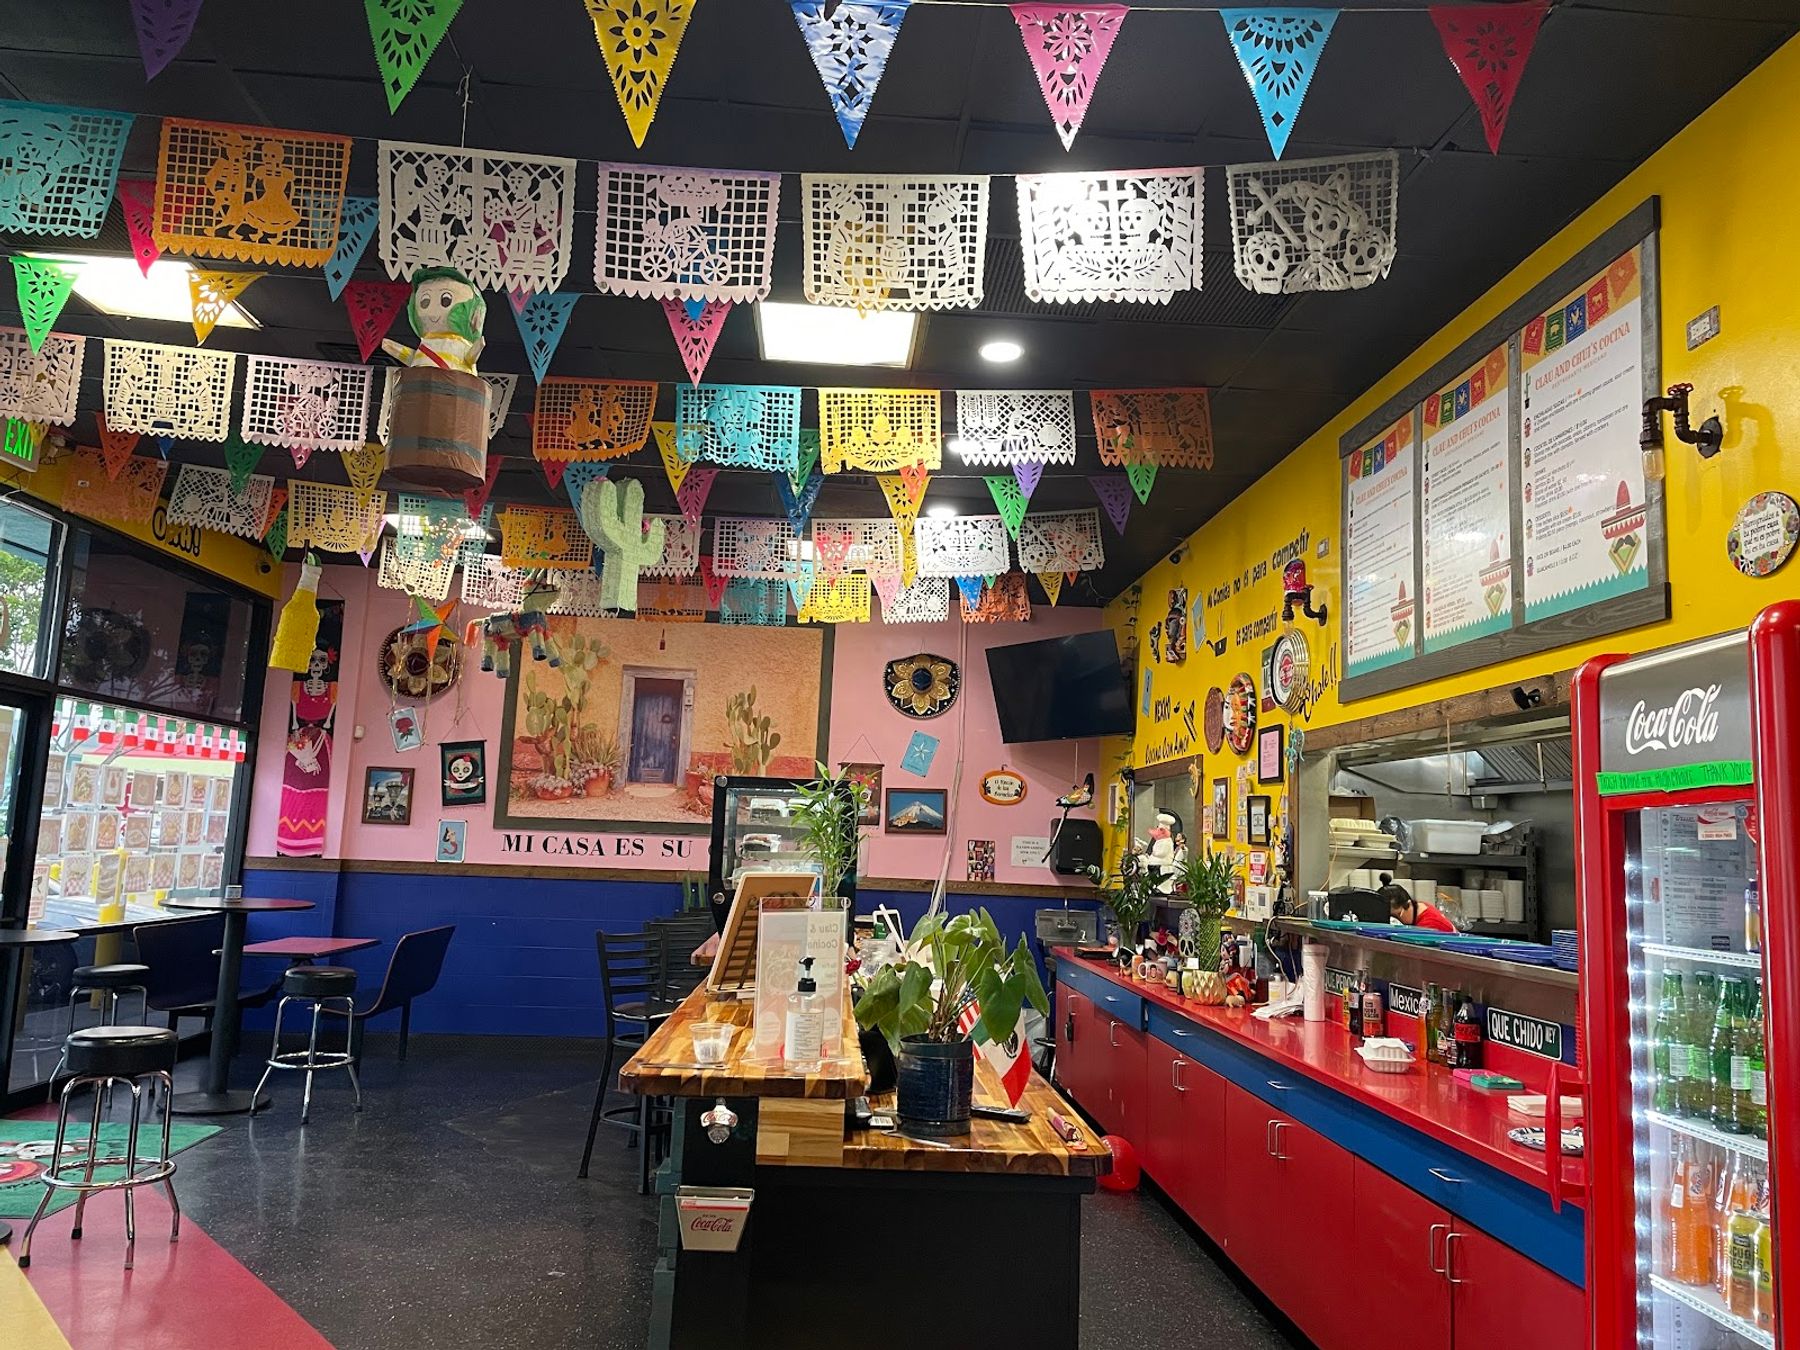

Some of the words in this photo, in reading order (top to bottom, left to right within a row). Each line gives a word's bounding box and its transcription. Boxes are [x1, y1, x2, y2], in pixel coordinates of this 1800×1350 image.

[1535, 369, 1552, 390] CLAU
[1554, 358, 1569, 378] AND
[1599, 320, 1630, 350] COCINA
[1234, 577, 1240, 594] no
[1252, 560, 1267, 587] para
[1272, 526, 1310, 571] competir
[1626, 684, 1722, 754] Coca-Cola
[1699, 764, 1730, 786] THANK
[1732, 762, 1746, 782] YOU
[501, 834, 534, 852] MI
[542, 836, 605, 856] CASA
[614, 838, 644, 856] ES
[661, 840, 694, 858] SU
[1391, 987, 1421, 1014] Mexic
[1492, 1012, 1511, 1042] QUE
[1513, 1018, 1544, 1050] CHIDO
[690, 1217, 735, 1232] Coca-Cola
